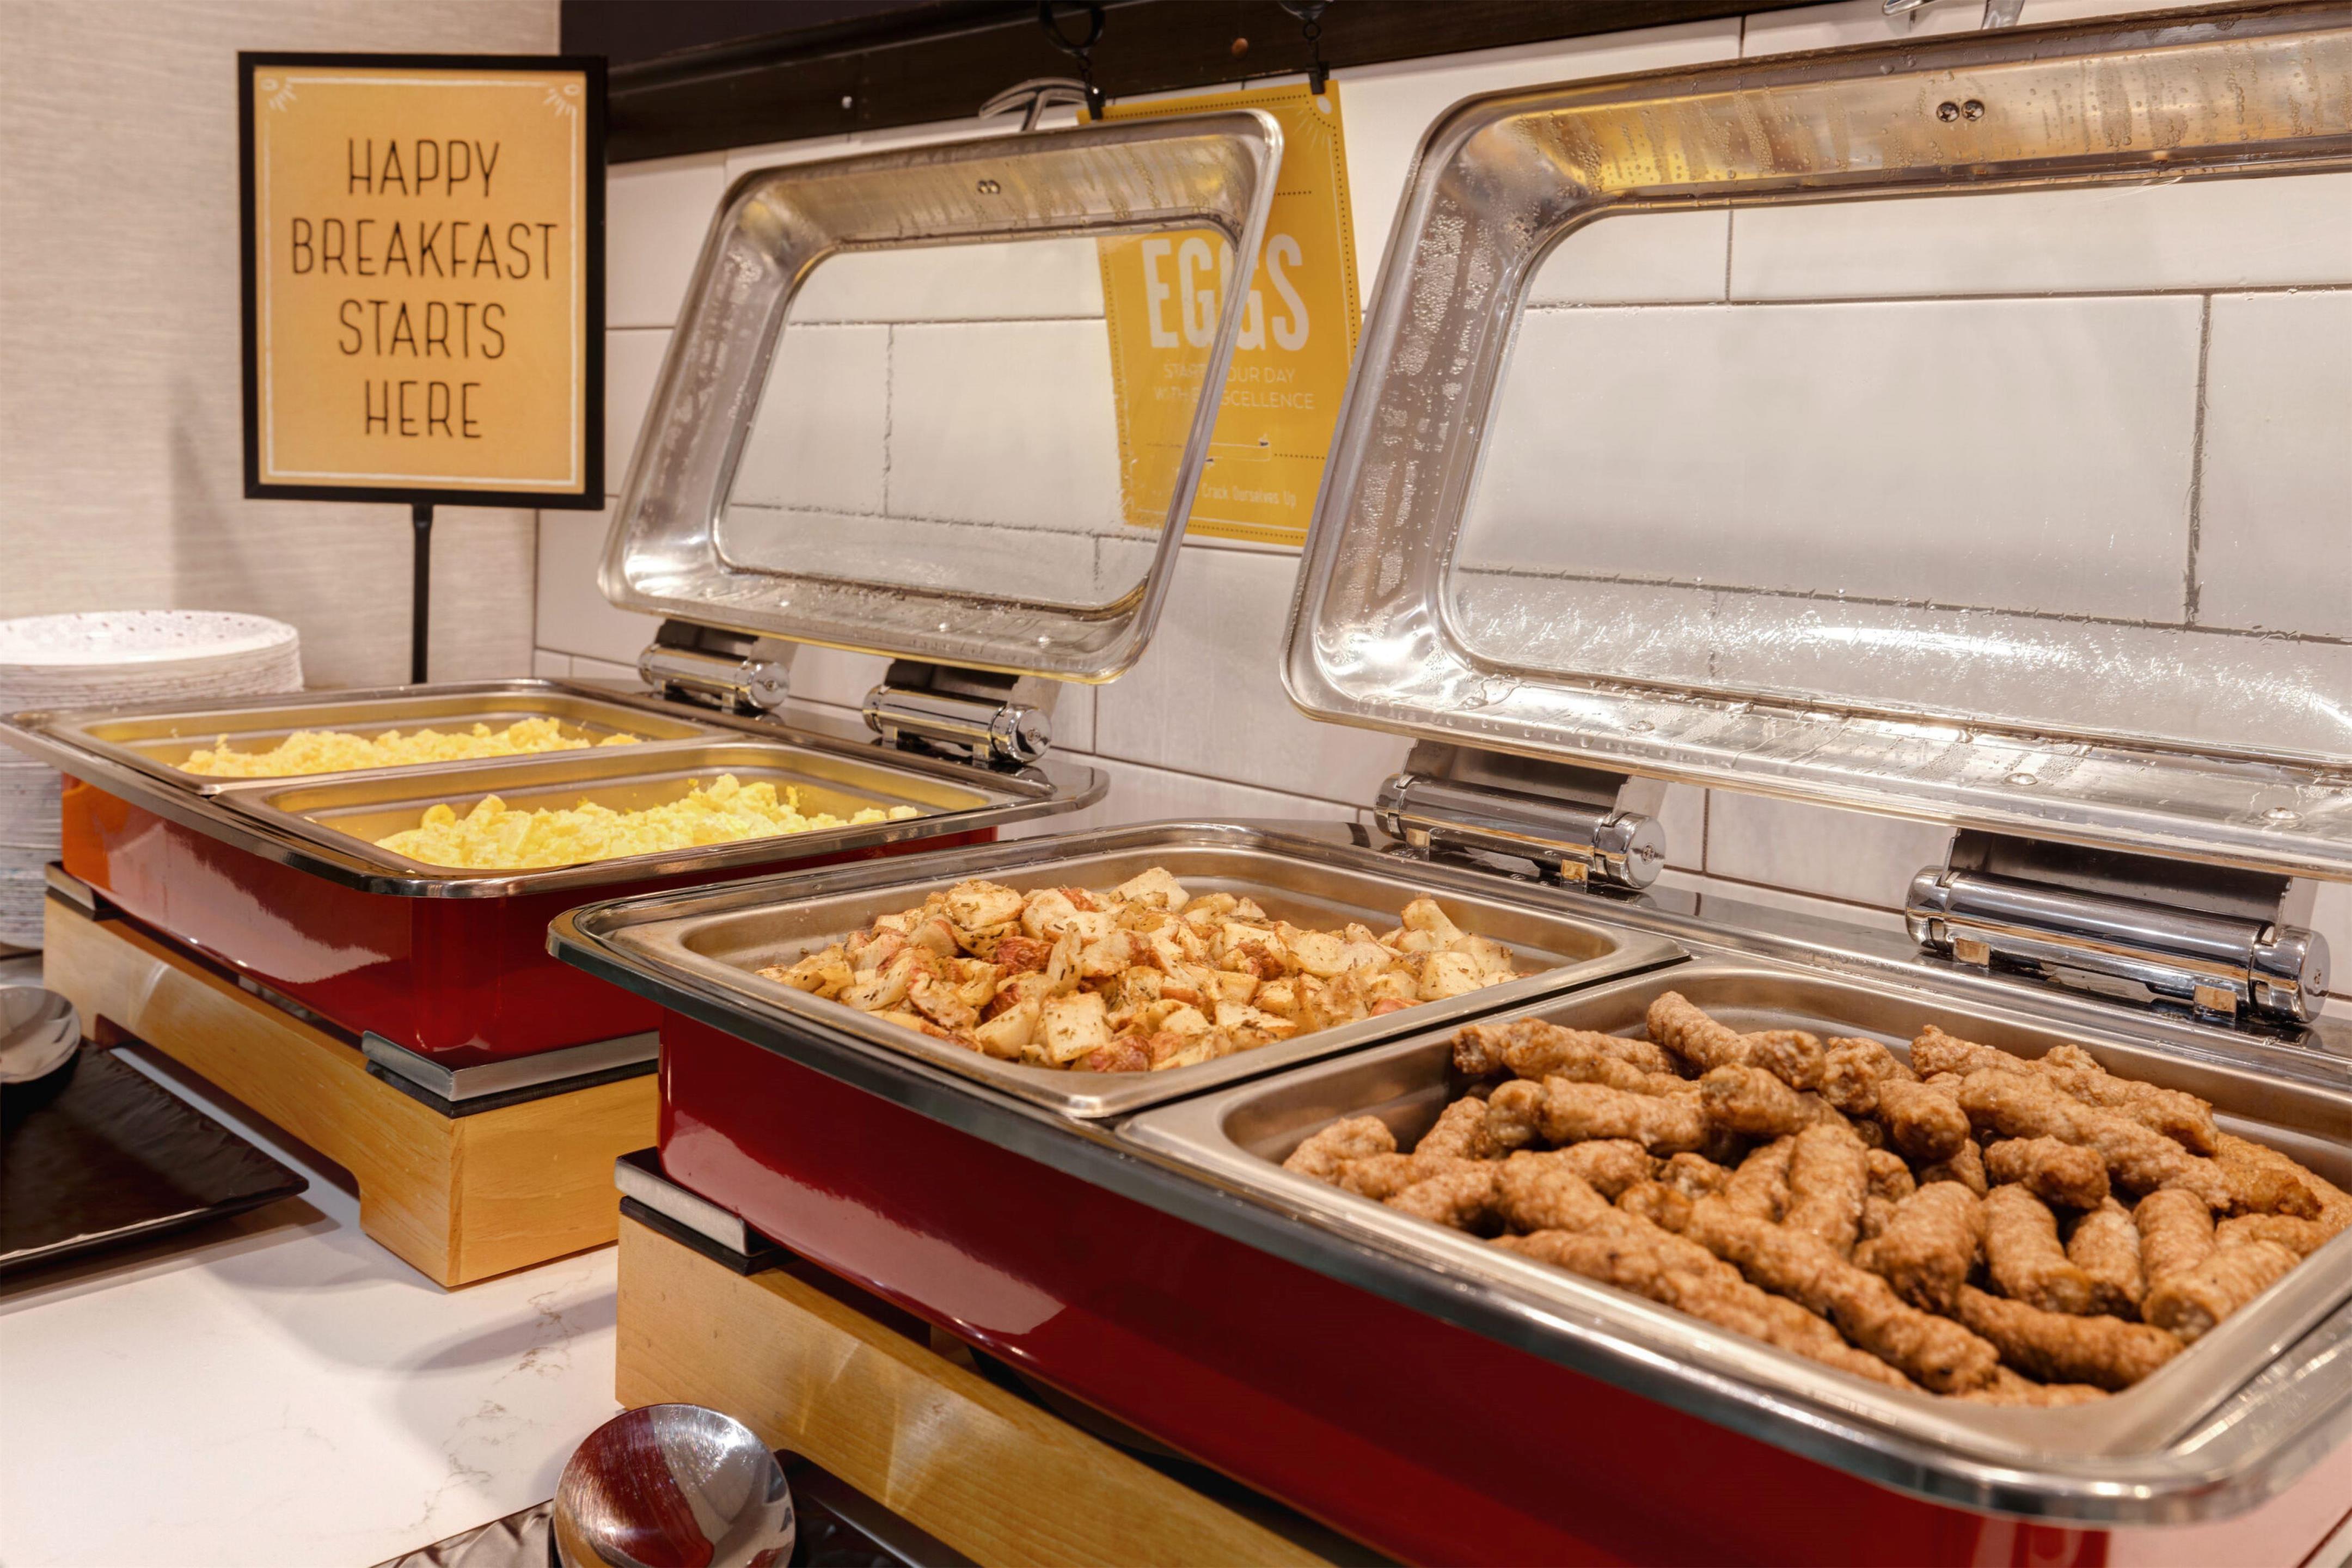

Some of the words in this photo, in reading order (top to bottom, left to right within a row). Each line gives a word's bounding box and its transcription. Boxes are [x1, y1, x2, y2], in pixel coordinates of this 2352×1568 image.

[348, 138, 500, 197] HAPPY
[292, 217, 558, 280] BREAKFAST
[339, 299, 505, 359] STARTS
[1225, 366, 1260, 383] OUR
[1263, 366, 1296, 383] DAY
[365, 380, 482, 438] HERE
